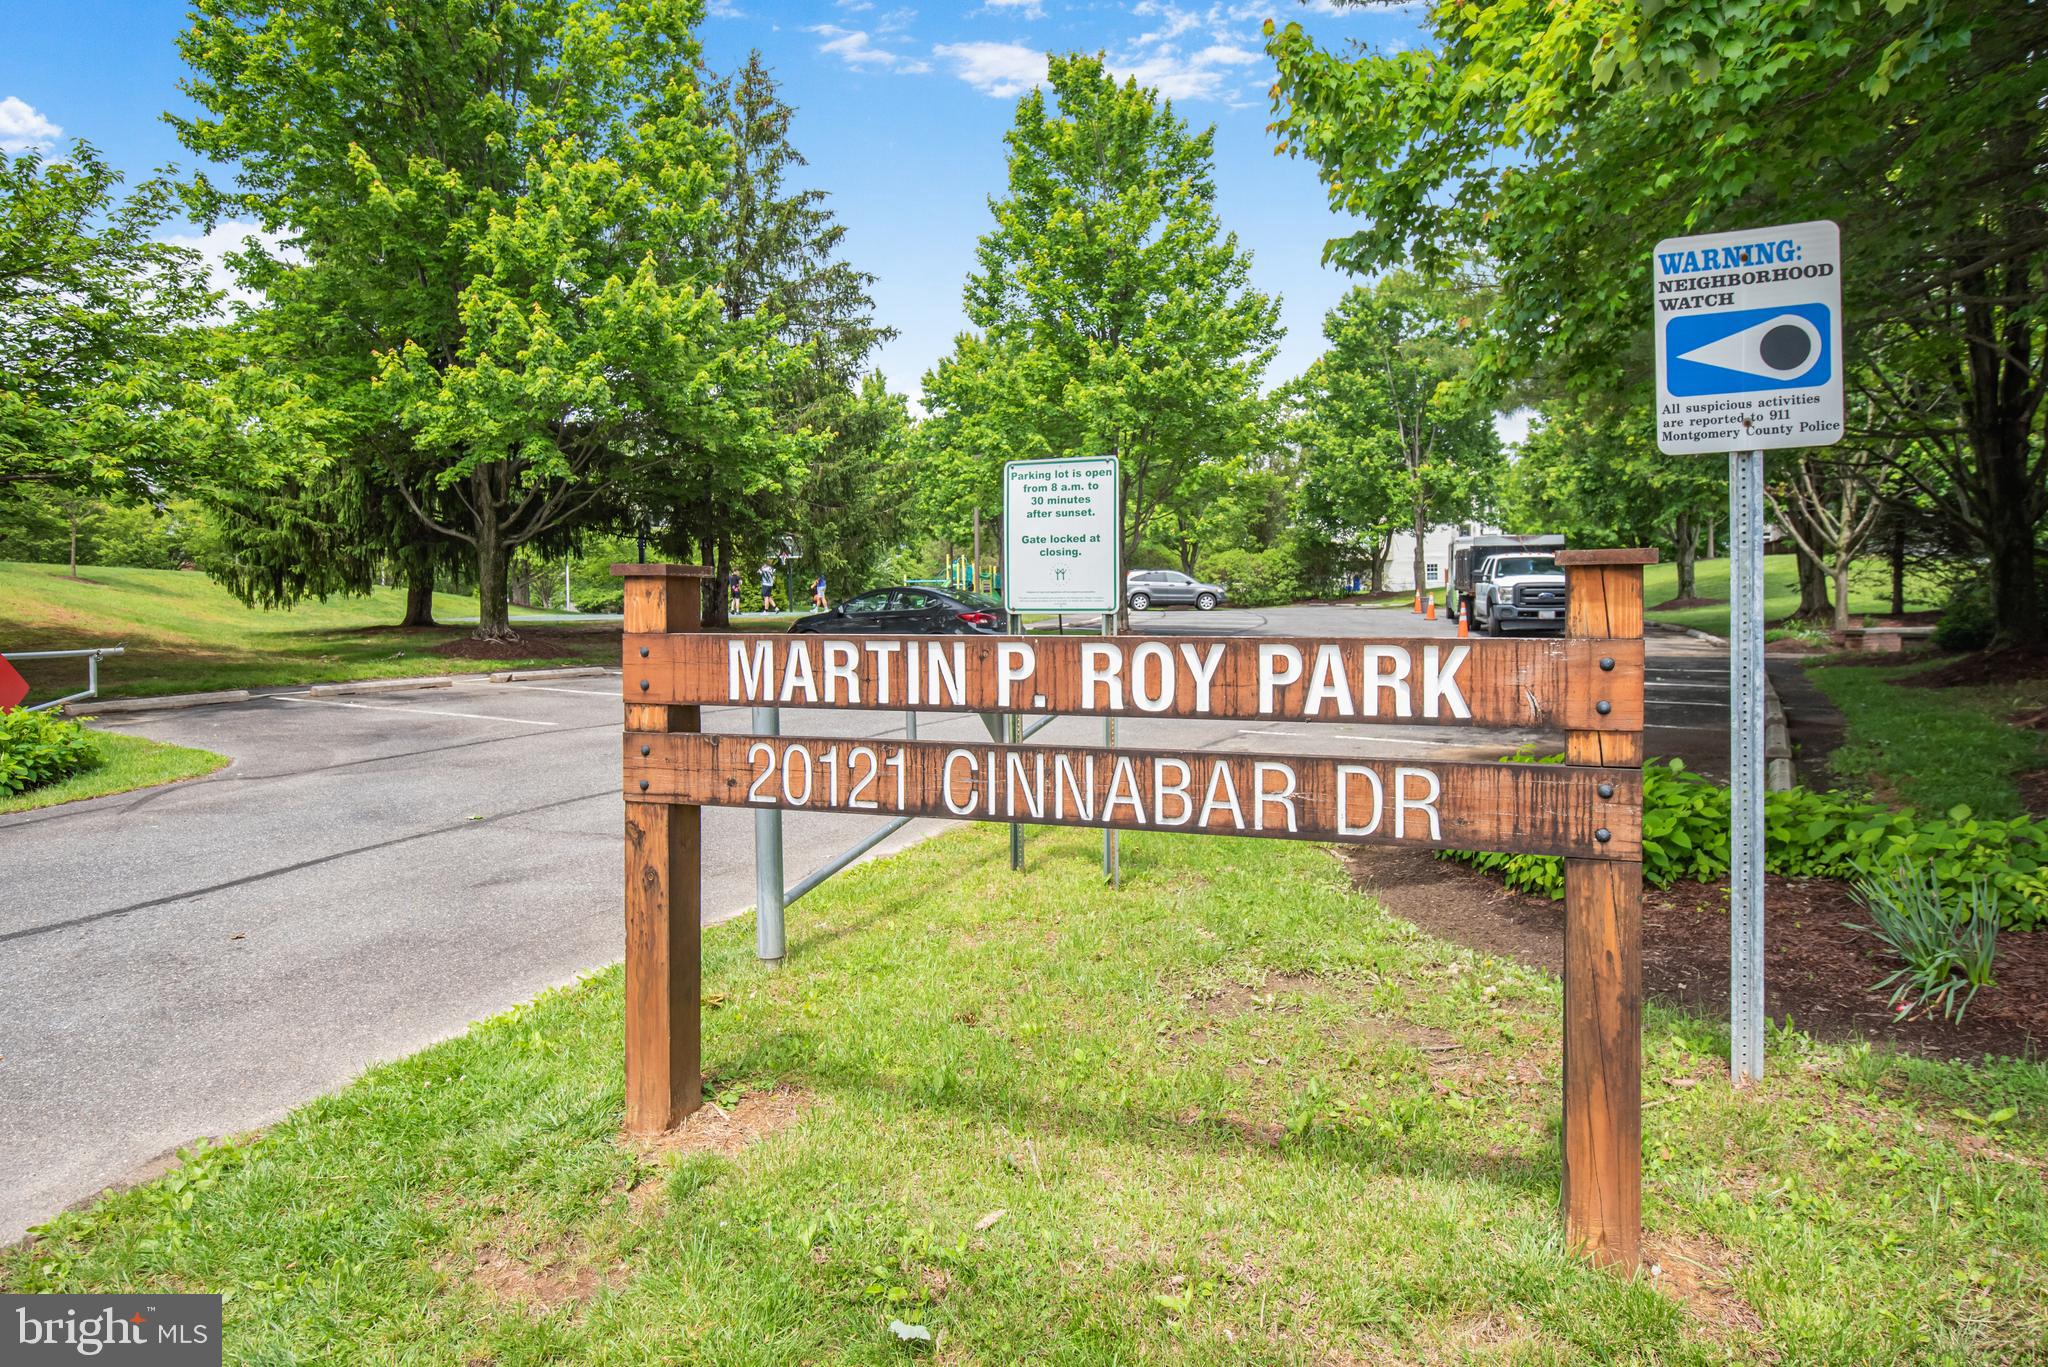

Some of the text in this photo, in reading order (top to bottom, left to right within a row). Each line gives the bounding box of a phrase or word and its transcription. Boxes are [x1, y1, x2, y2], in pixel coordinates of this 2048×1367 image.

[1658, 240, 1802, 275] WARNING:
[1658, 263, 1833, 294] NEIGHBORHOOD
[1659, 292, 1735, 311] WATCH
[1662, 393, 1820, 416] All suspicious activities
[1663, 409, 1790, 430] are reported to 911
[1662, 420, 1840, 442] Montgomery County Police
[1011, 468, 1112, 481] Parking lot is open
[1023, 482, 1099, 493] from 8 a.m. to
[1031, 495, 1091, 505] 30 minutes
[1026, 508, 1096, 519] after sunset.
[1021, 534, 1101, 544] Gate locked at
[1039, 547, 1082, 558] closing.
[728, 639, 1472, 720] MARTIN P. ROY PARK
[748, 742, 1442, 841] 20121 CINNABAR DR
